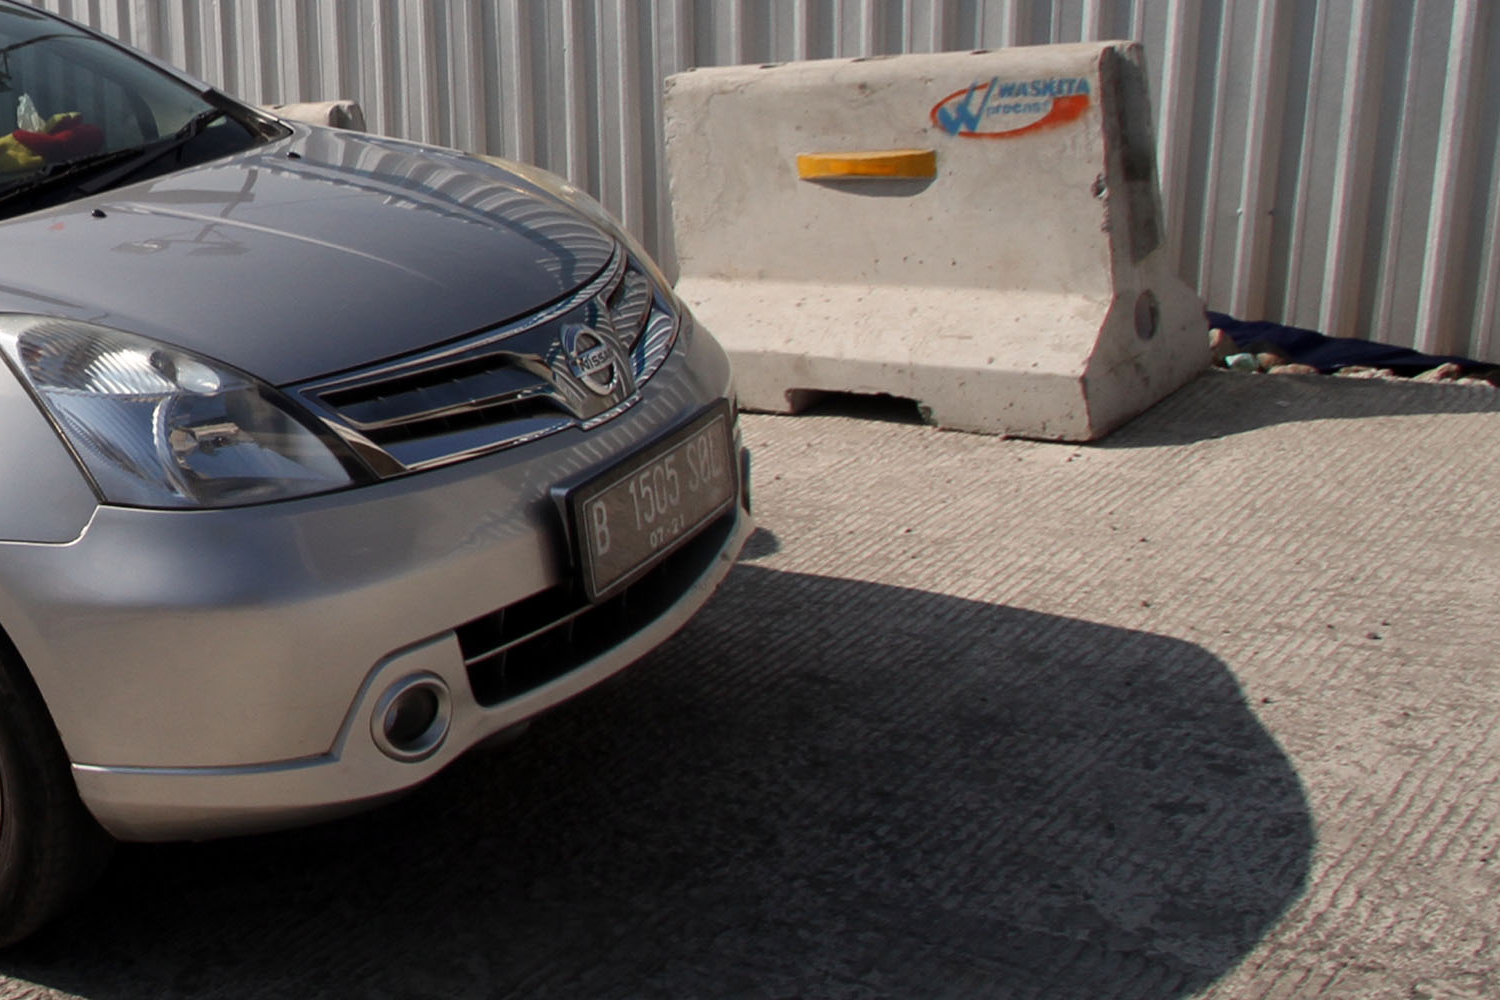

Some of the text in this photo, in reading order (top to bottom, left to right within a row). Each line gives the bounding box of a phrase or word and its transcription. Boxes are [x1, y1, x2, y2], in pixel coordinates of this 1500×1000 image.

[998, 77, 1091, 98] WASKITA
[986, 101, 1050, 118] precast
[592, 501, 610, 555] B
[629, 457, 680, 531] 1505
